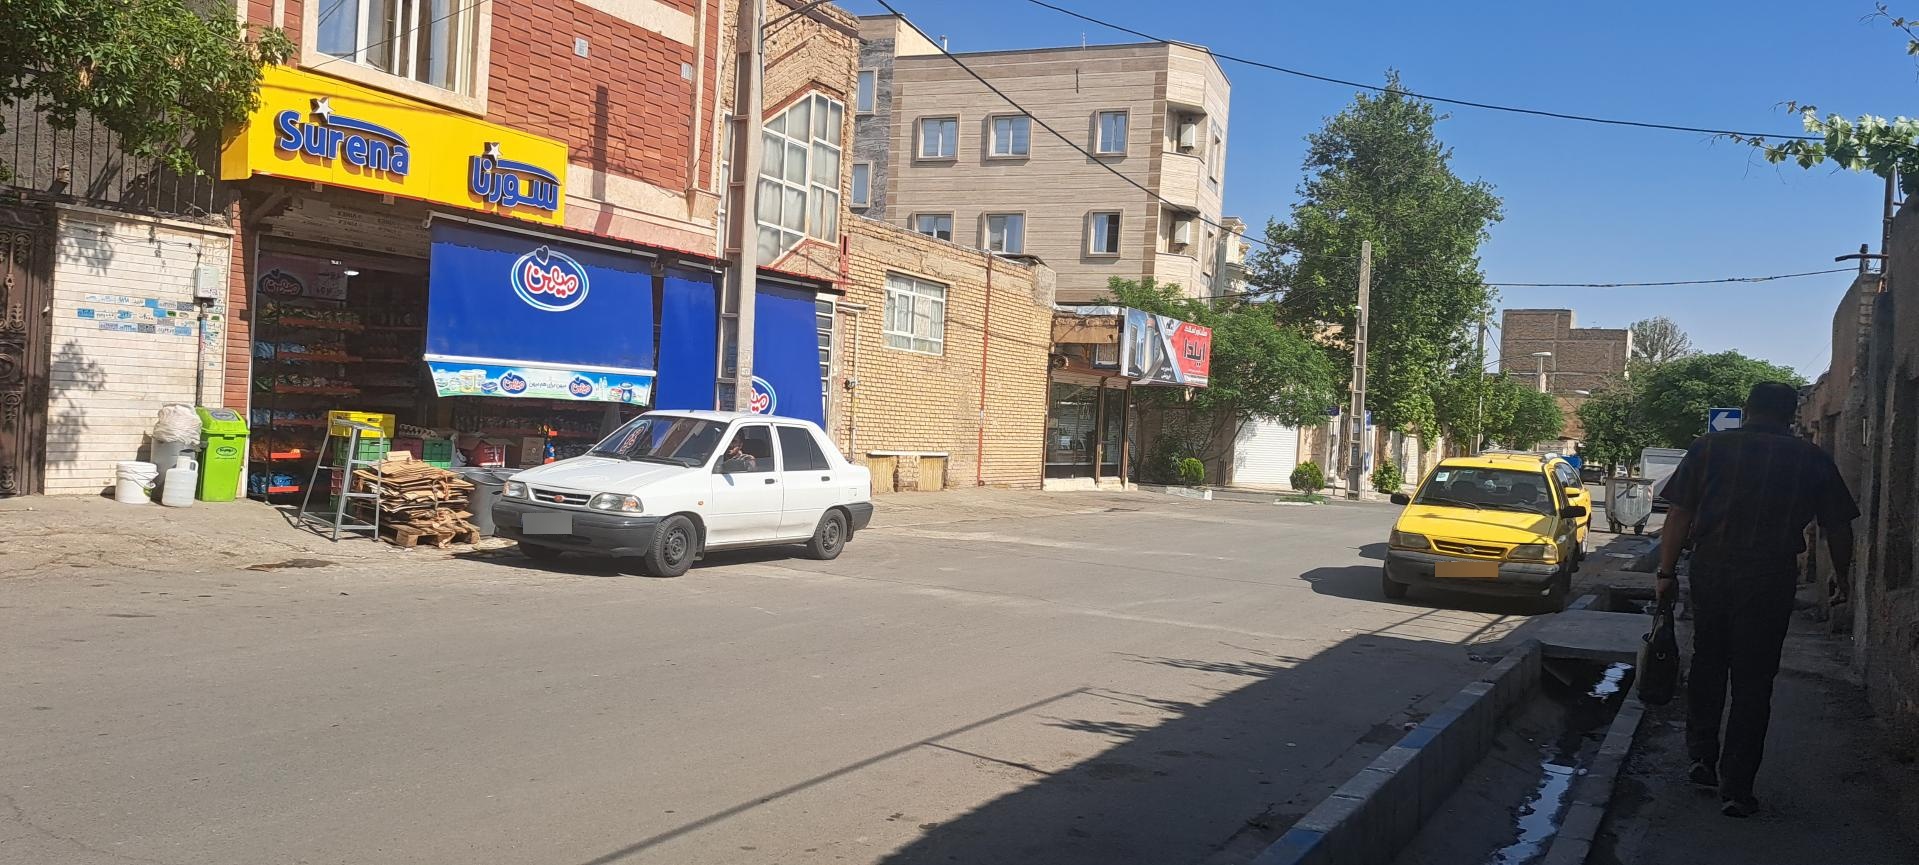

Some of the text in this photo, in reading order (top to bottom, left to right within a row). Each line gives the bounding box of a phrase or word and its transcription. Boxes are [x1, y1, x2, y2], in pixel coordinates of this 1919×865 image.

[274, 109, 410, 177] Surena
[472, 154, 560, 212] سورنا
[523, 260, 580, 299] میهن
